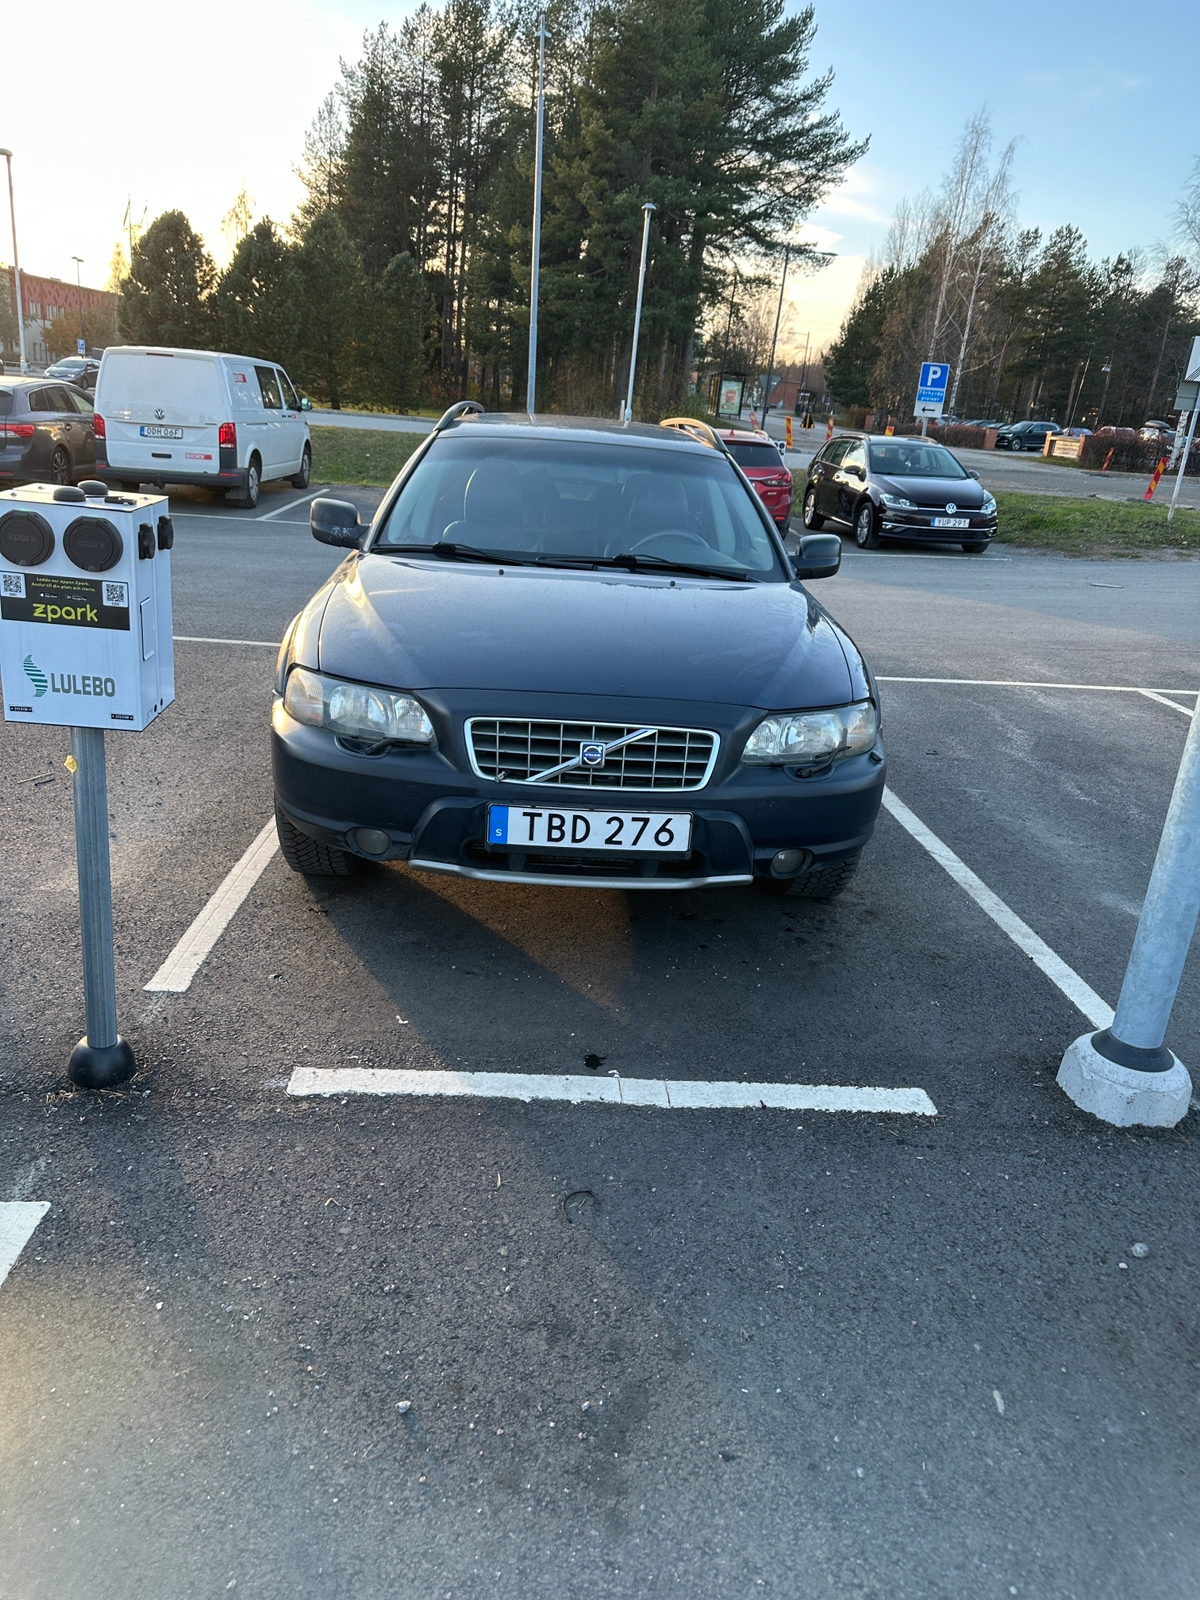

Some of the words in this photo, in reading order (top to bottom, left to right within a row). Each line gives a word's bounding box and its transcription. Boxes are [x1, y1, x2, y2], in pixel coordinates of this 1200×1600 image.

[927, 366, 942, 386] P
[147, 427, 162, 435] ODH
[163, 428, 179, 436] 06F
[937, 518, 951, 526] YUP
[8, 533, 37, 543] zpark
[77, 539, 106, 549] zpark
[32, 603, 99, 622] zpark
[50, 672, 116, 698] LULEBO
[495, 828, 503, 837] S
[522, 811, 591, 844] TBD
[604, 816, 675, 847] 276
